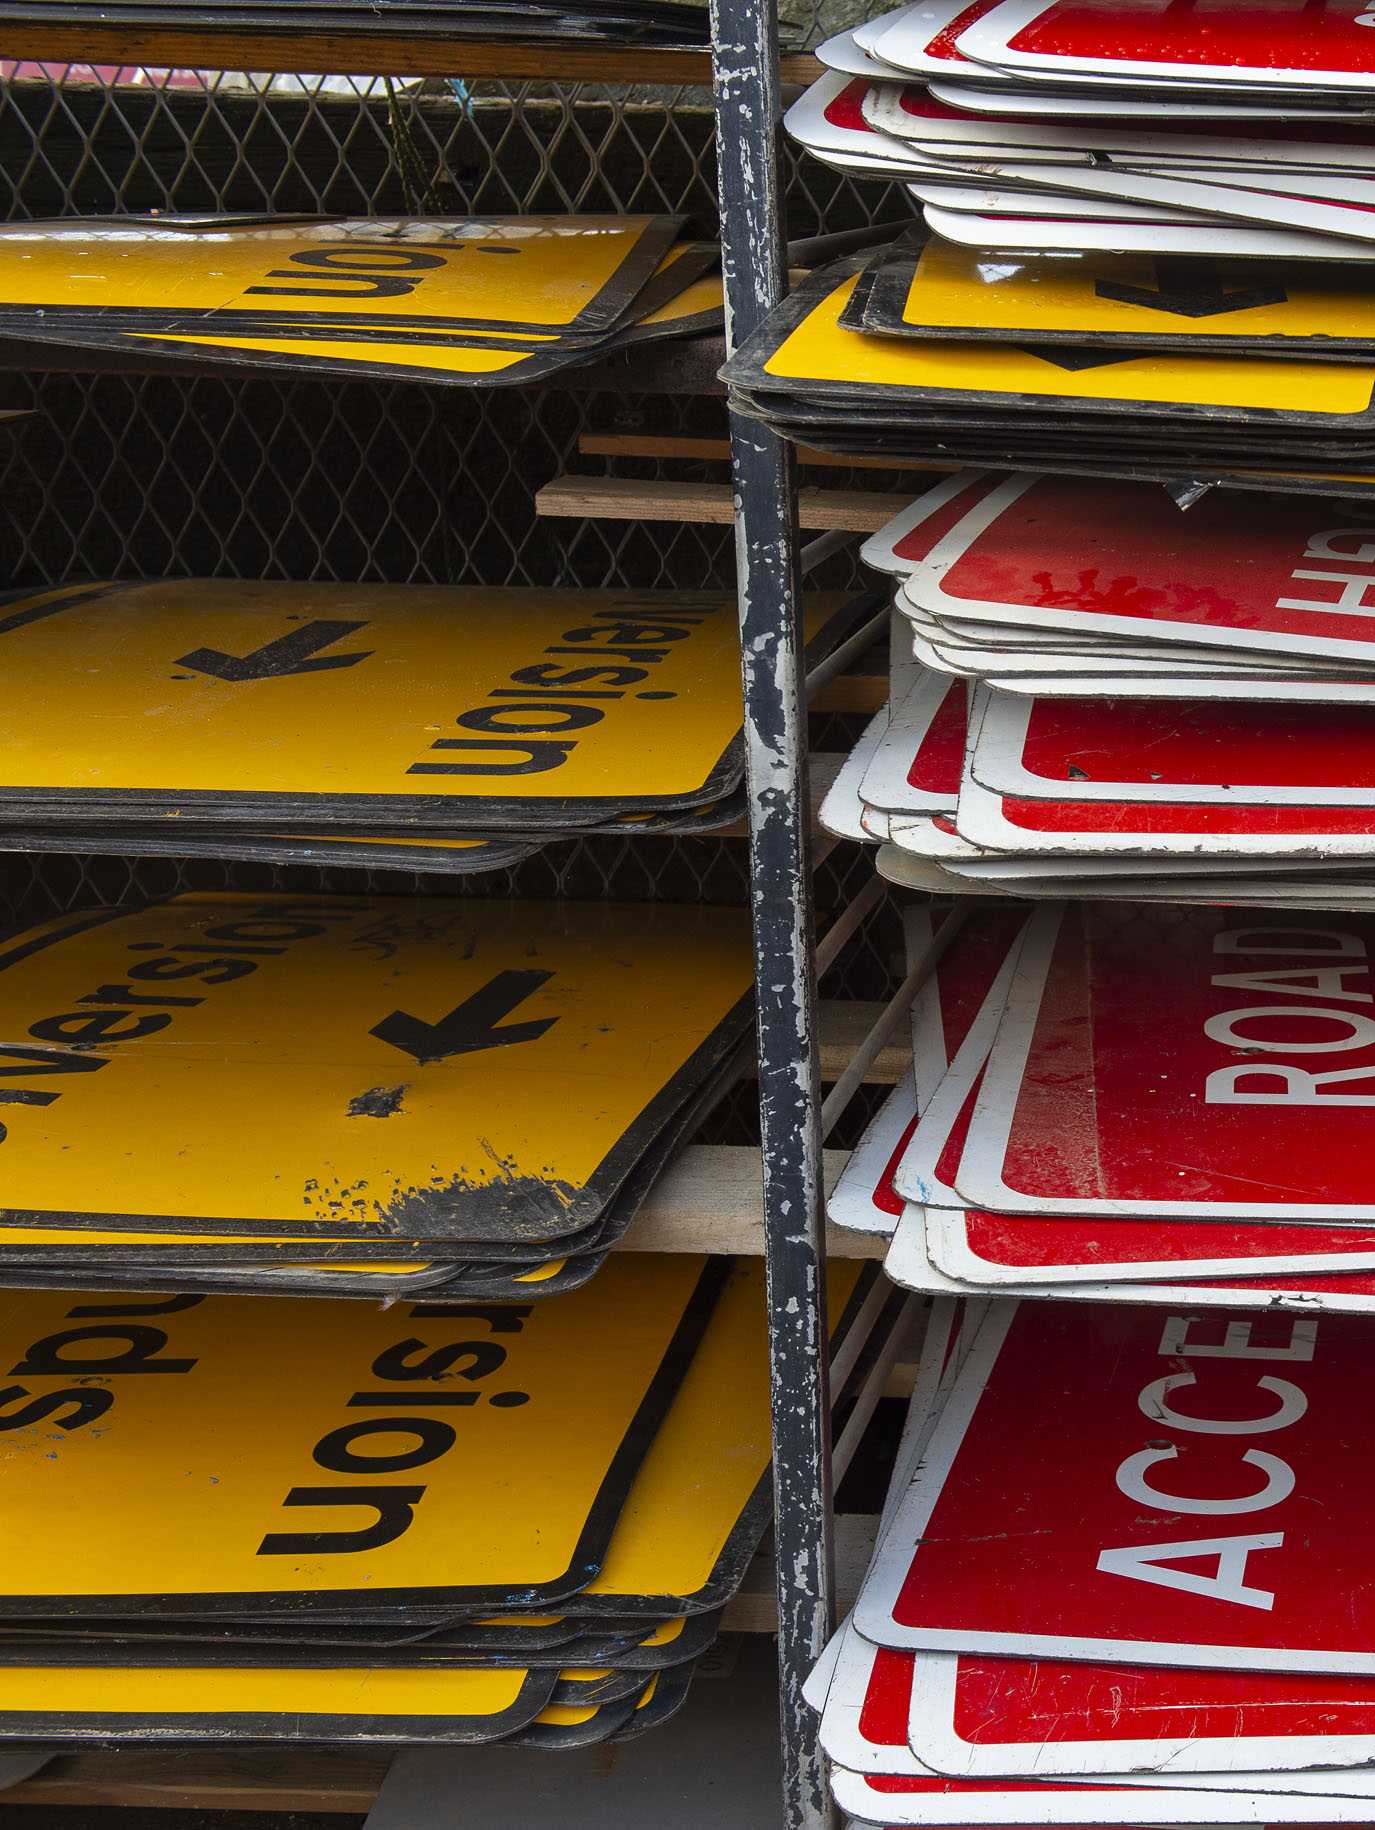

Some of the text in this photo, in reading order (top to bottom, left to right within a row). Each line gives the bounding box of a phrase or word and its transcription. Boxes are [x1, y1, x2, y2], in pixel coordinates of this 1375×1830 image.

[243, 237, 522, 299] ion
[256, 1305, 535, 1555] rsion
[1096, 1315, 1319, 1612] ACCE
